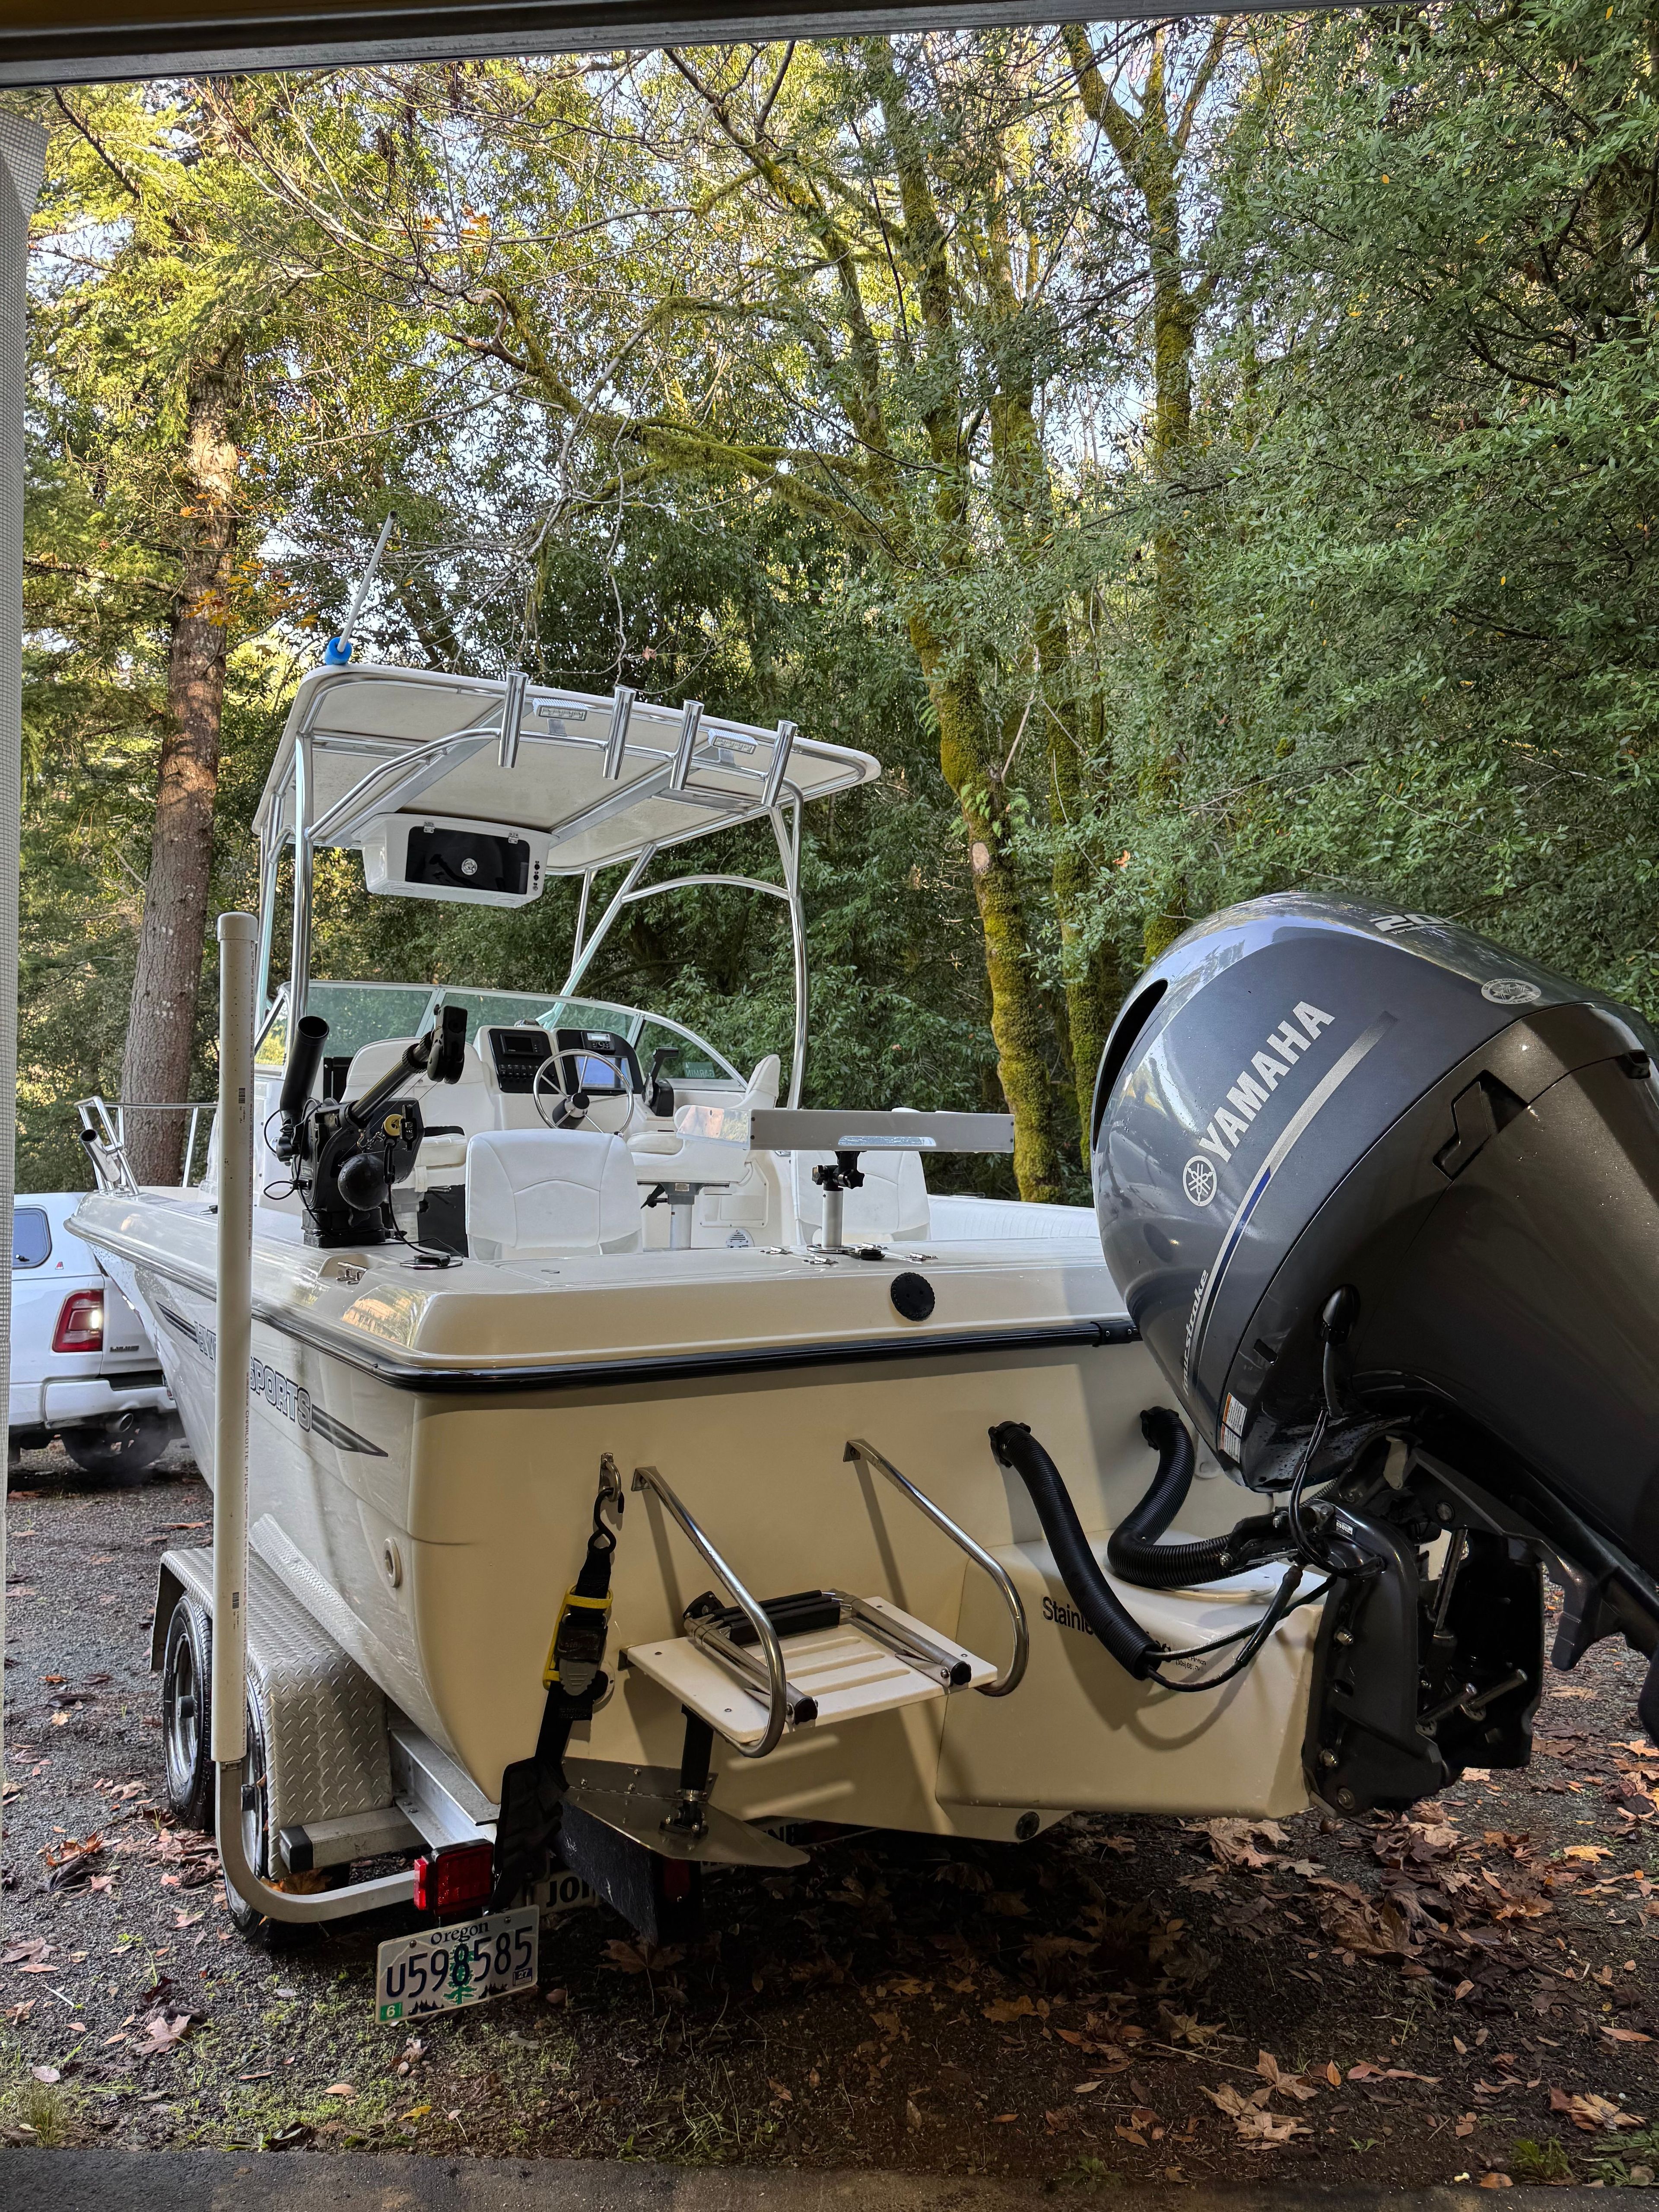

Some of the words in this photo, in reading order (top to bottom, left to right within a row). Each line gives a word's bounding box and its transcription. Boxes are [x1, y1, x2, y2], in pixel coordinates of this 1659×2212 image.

[1198, 1001, 1335, 1163] YAMAHA
[431, 1922, 490, 1944] Oregon
[386, 1926, 533, 1998] U598585
[518, 1969, 529, 1978] 27
[387, 2005, 395, 2017] 6
